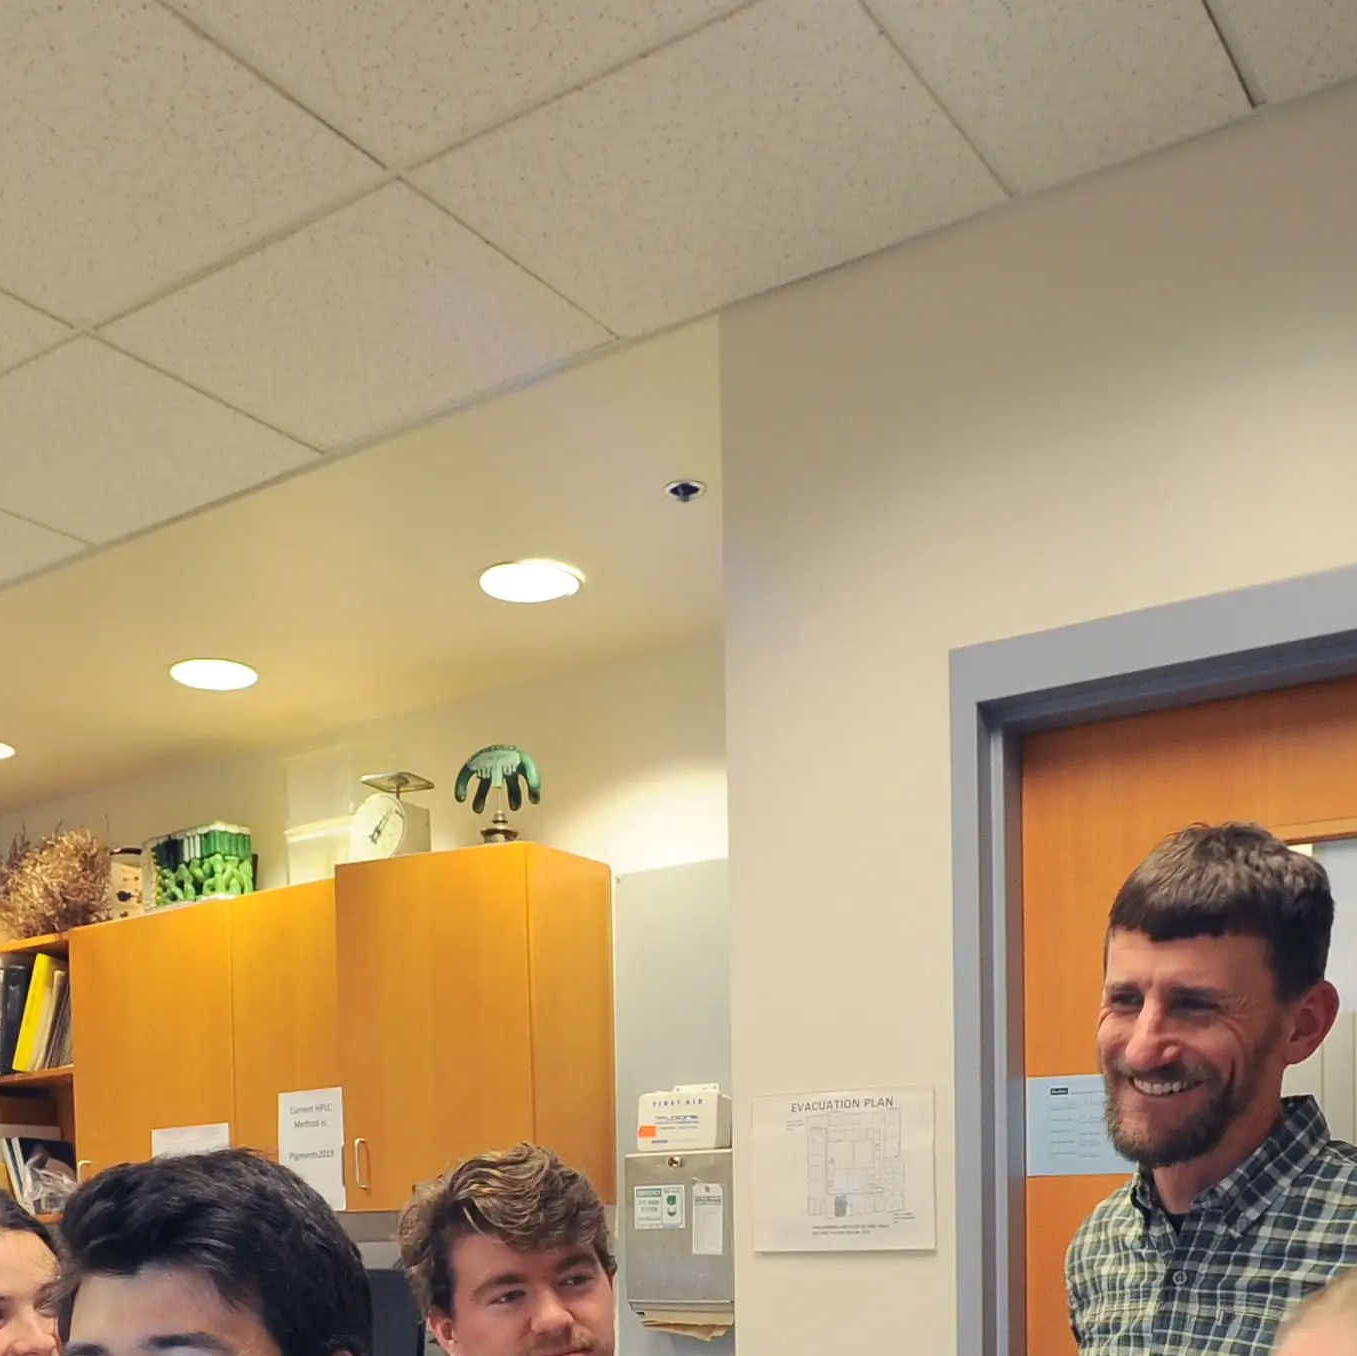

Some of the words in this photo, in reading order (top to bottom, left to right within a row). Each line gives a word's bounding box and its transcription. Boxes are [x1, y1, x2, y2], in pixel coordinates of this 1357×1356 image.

[652, 1099, 681, 1107] FIRST
[791, 1098, 860, 1112] EVACUATION
[864, 1097, 894, 1108] PLAN
